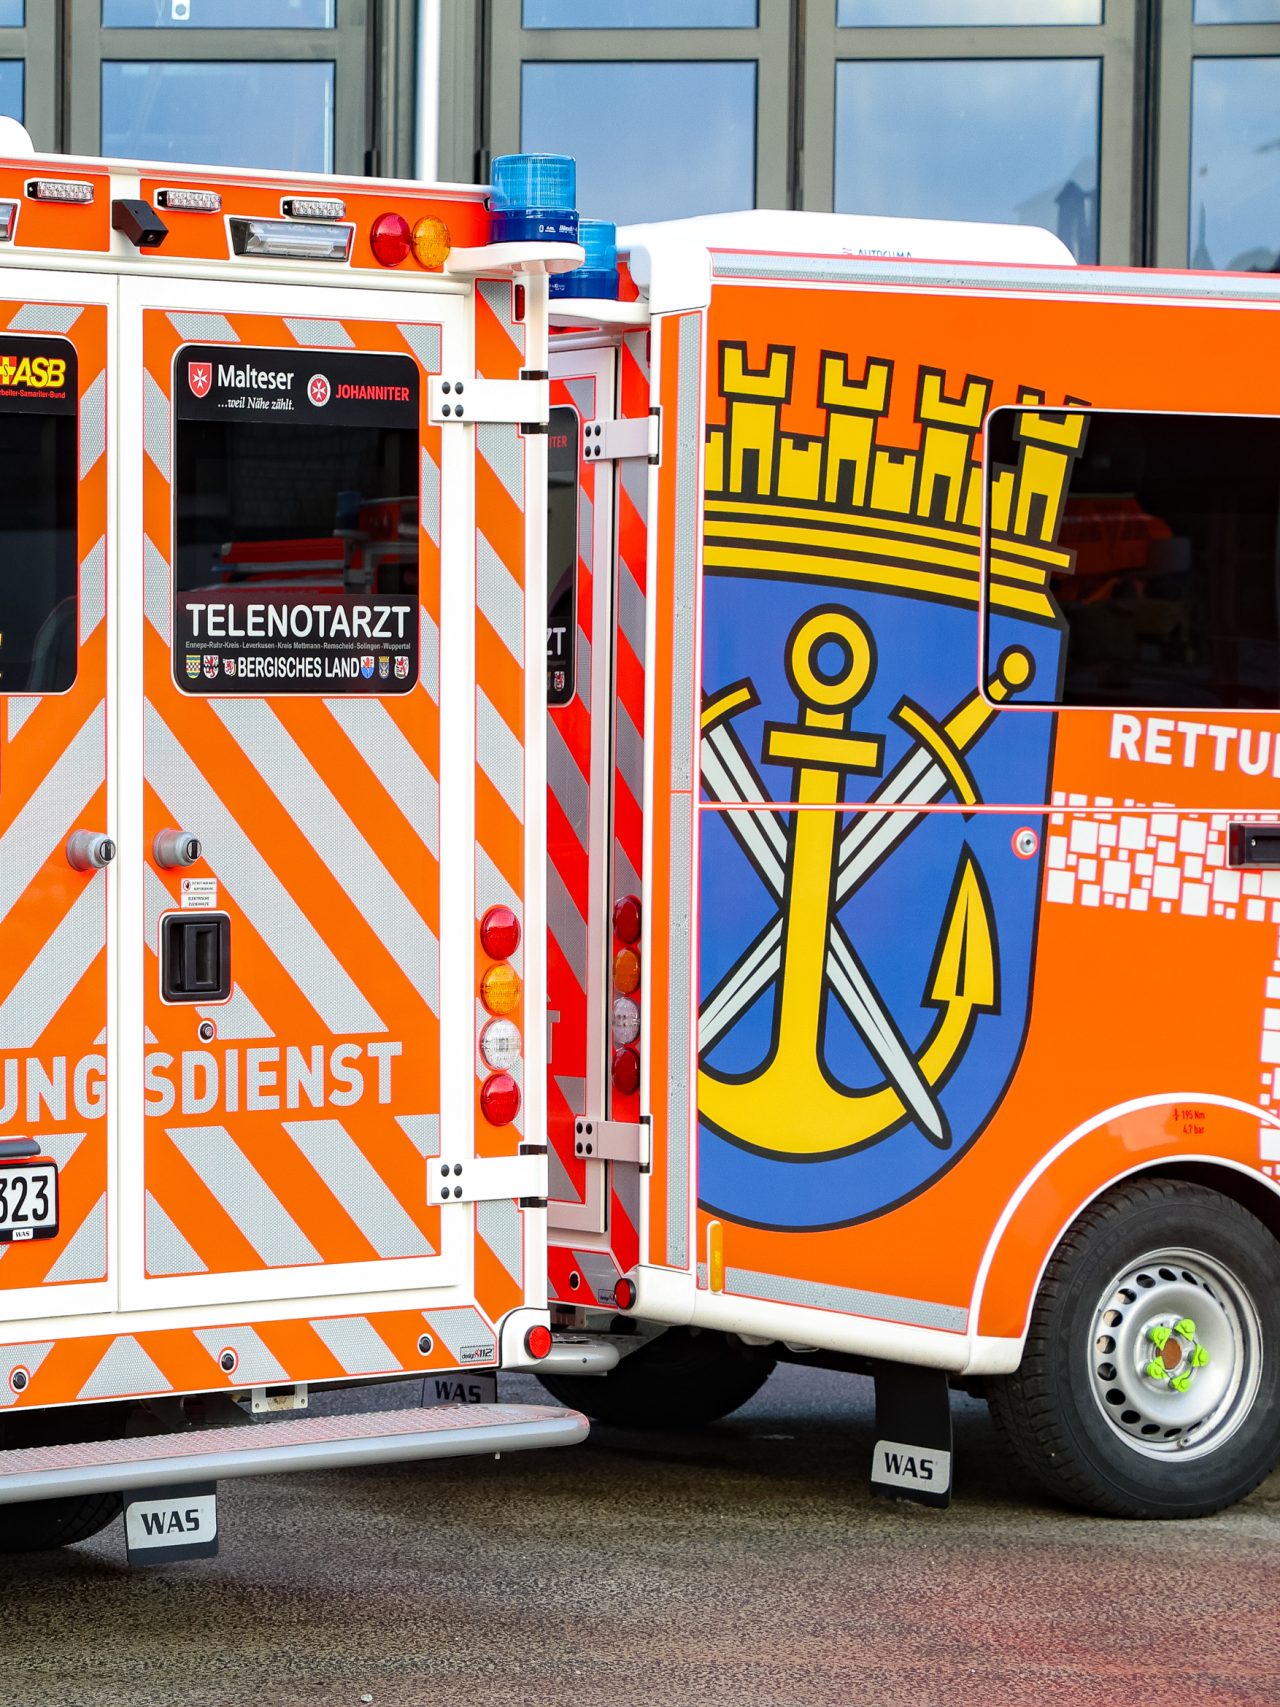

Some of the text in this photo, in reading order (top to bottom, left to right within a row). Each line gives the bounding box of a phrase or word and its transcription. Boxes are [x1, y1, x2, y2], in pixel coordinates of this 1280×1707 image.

[11, 357, 66, 388] ASB
[218, 364, 295, 390] Malteser
[247, 396, 270, 410] Nähe
[271, 397, 295, 411] zählt.
[335, 384, 410, 402] JOHANNITER
[185, 603, 411, 638] TELENOTARZT
[238, 656, 360, 678] BERGISCHES LAND
[434, 1380, 481, 1404] WAS
[884, 1452, 934, 1481] WAS
[140, 1508, 201, 1536] WAS
